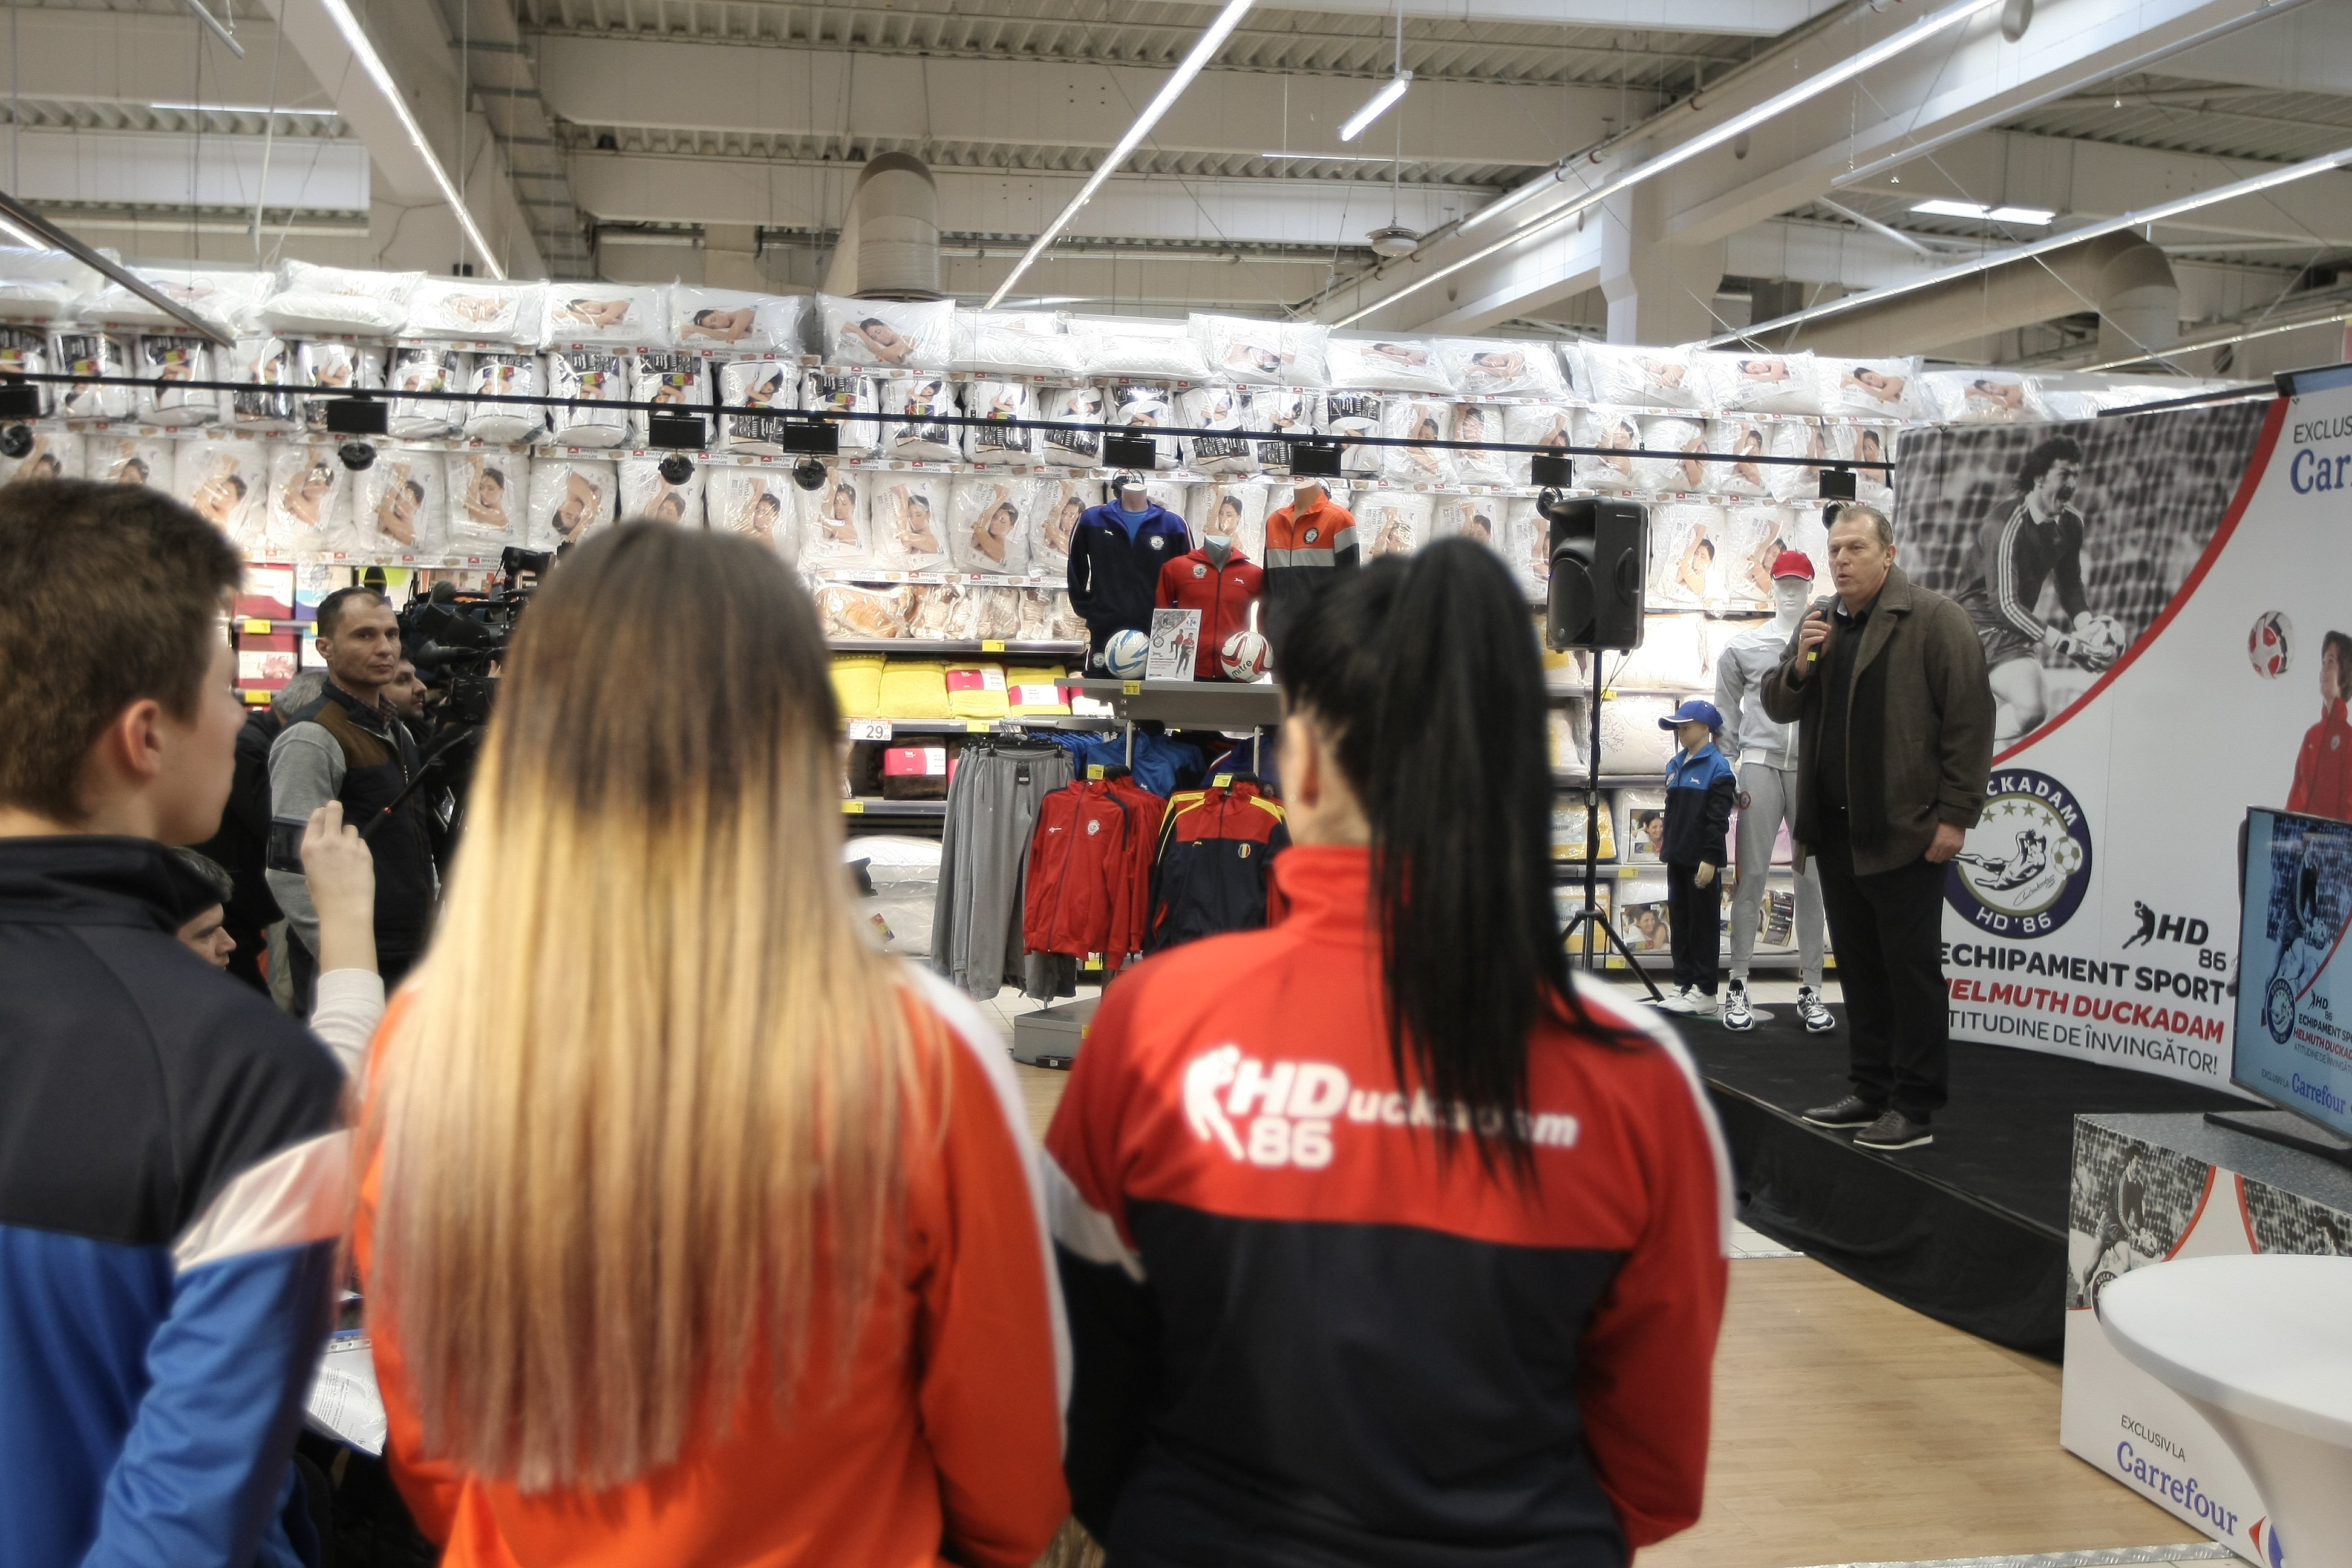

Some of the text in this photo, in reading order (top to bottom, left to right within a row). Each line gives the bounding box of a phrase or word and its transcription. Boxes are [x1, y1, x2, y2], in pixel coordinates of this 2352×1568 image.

[2290, 449, 2352, 494] Car
[1232, 659, 1253, 677] mitre
[866, 725, 883, 739] 29
[1976, 906, 2008, 930] HD
[2156, 914, 2209, 946] HD
[1941, 942, 2225, 1005] ECHIPAMENT SPORT
[2198, 949, 2226, 972] 86
[2072, 995, 2225, 1044] DUCKADAM
[2315, 997, 2328, 1010] HD
[1949, 1010, 2218, 1076] TITUDINE DE ÎNVINGĂTOR!
[2293, 1027, 2325, 1048] HELMUTH
[2298, 1013, 2342, 1039] ECHIPAMENT
[2292, 1073, 2346, 1114] Carrefour
[1246, 1114, 1334, 1169] 86
[2121, 1414, 2186, 1462] EXCLUSIV LA
[2117, 1441, 2238, 1536] Carrefour
